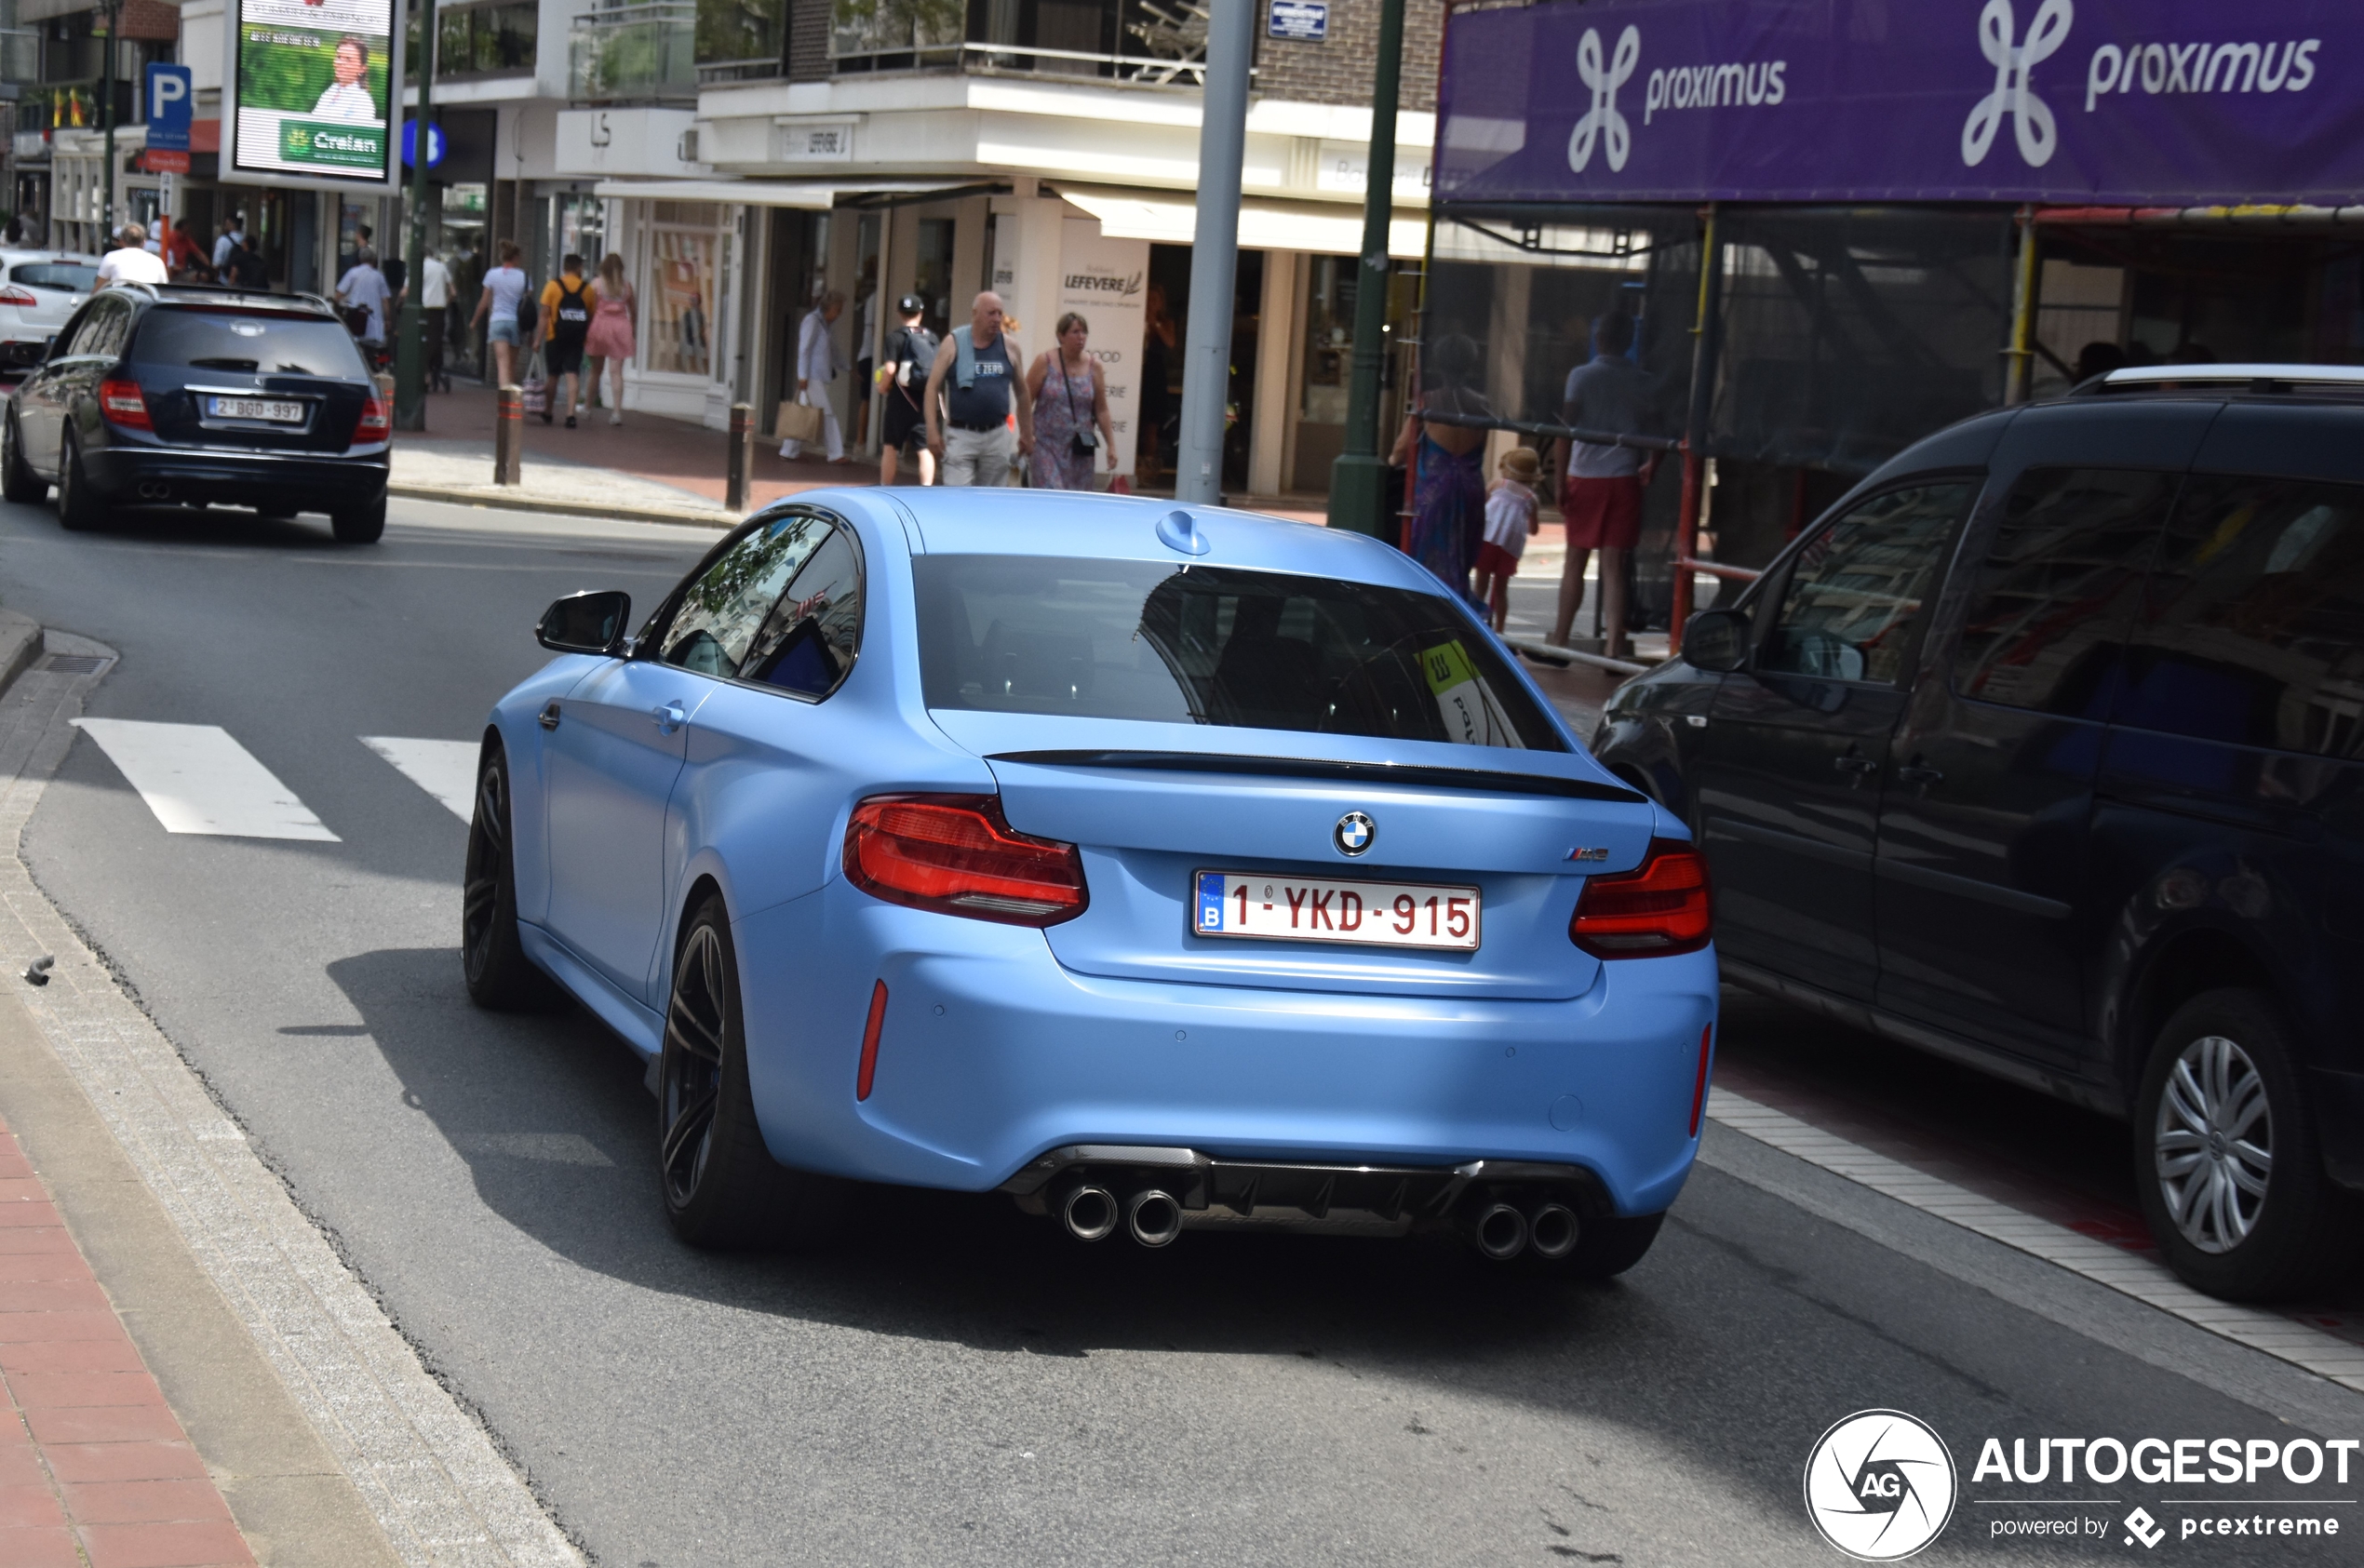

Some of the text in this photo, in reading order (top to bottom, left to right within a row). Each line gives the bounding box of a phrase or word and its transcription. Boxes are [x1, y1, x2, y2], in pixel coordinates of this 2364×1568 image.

[153, 73, 185, 119] P
[1644, 60, 1787, 126] proximus
[2085, 39, 2321, 113] proximus
[1064, 275, 1124, 291] LEFEVERE
[1204, 906, 1220, 927] B
